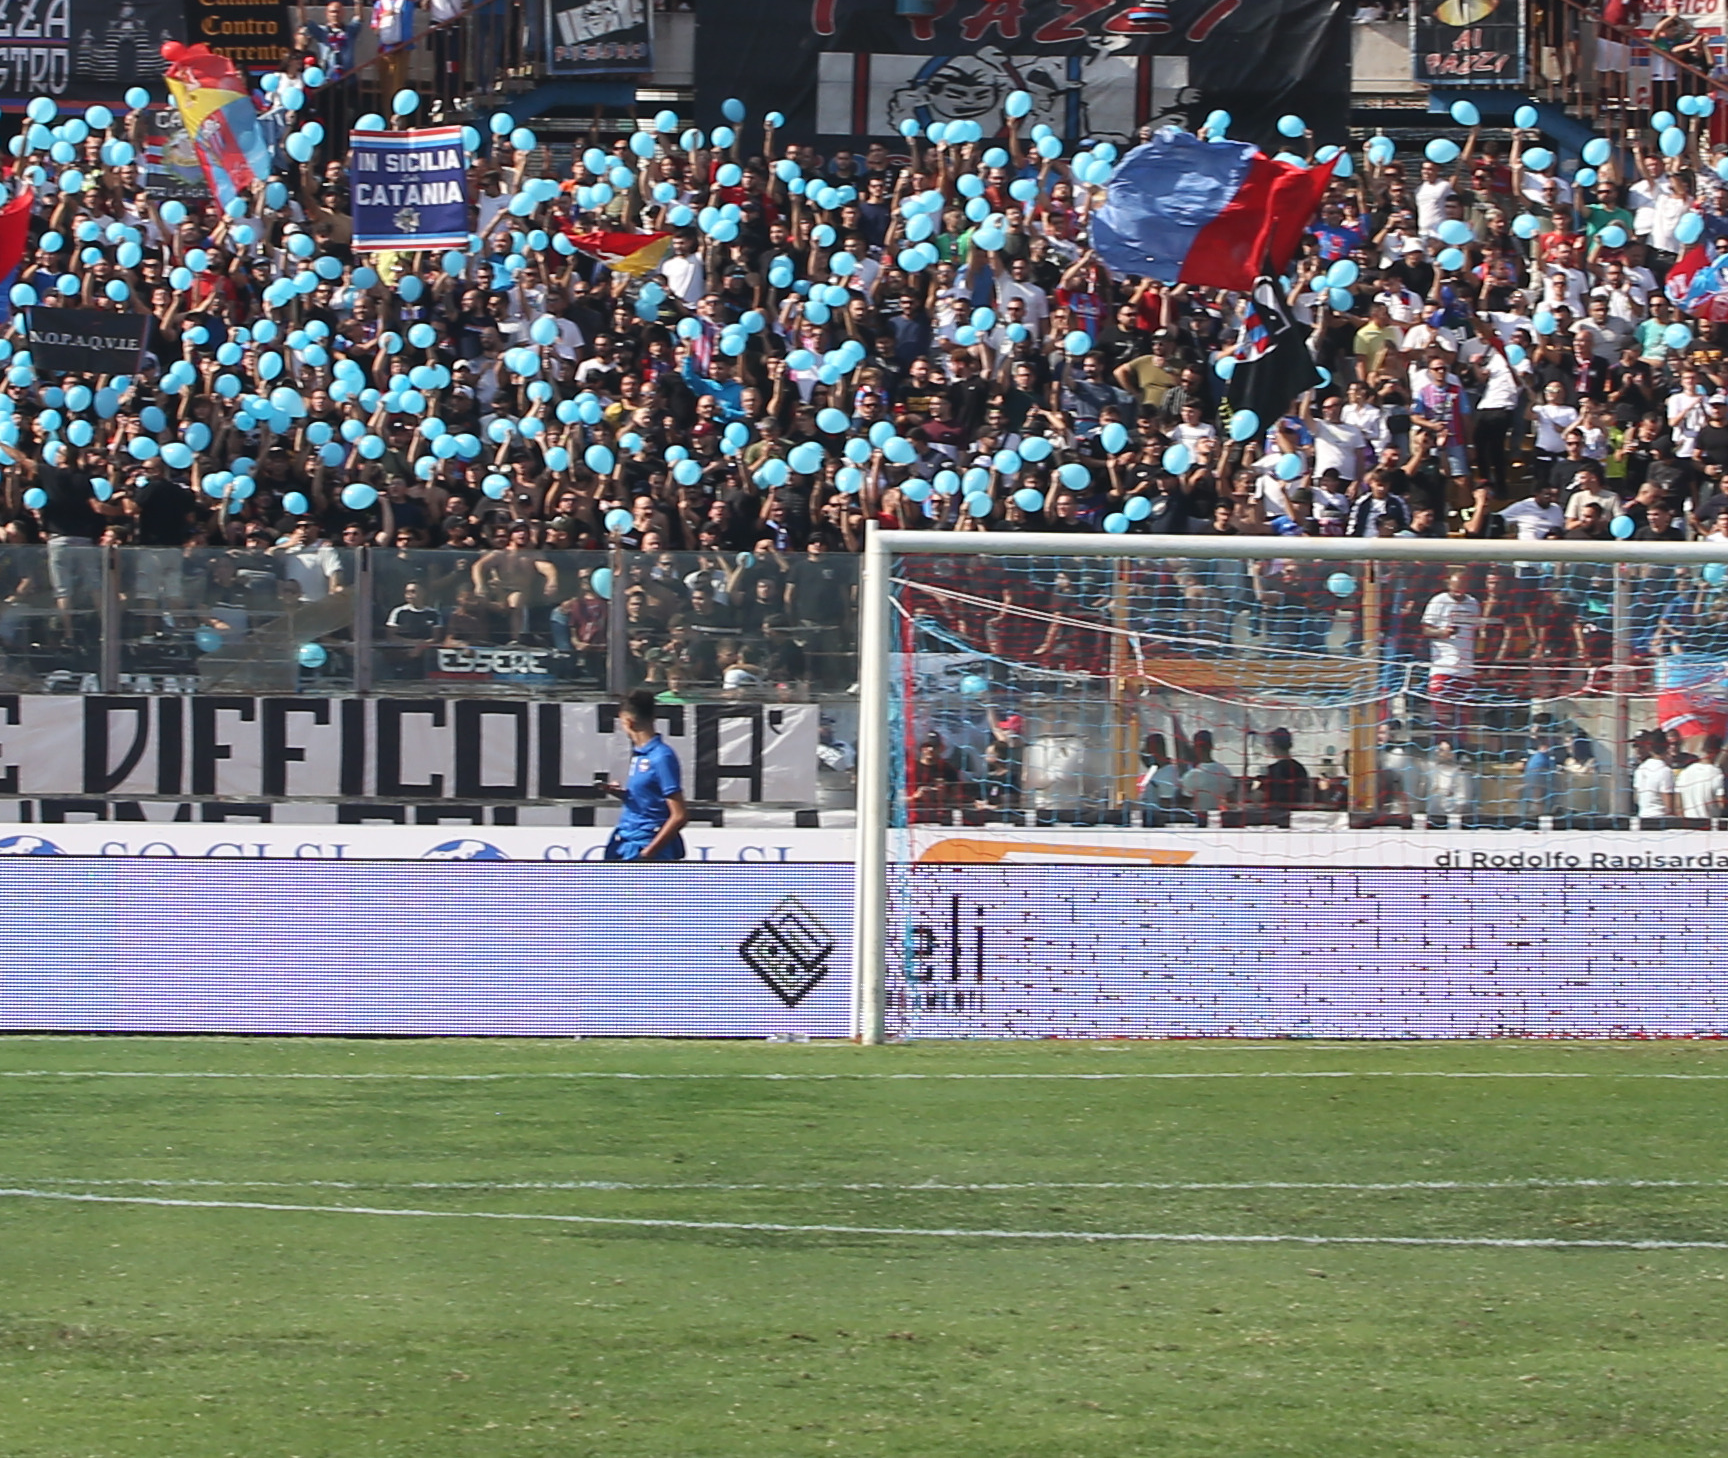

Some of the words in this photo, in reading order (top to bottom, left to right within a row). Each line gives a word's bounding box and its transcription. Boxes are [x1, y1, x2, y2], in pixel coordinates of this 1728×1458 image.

[201, 15, 279, 36] Contro
[1452, 28, 1483, 51] AI
[206, 42, 289, 61] orrente
[1424, 50, 1510, 76] PAZZI
[358, 153, 379, 171] IN
[385, 149, 461, 172] SICILIA
[355, 181, 464, 206] CATANIA
[437, 648, 549, 674] ESSERE
[1435, 851, 1460, 868] di
[1472, 851, 1580, 868] Rodolfo
